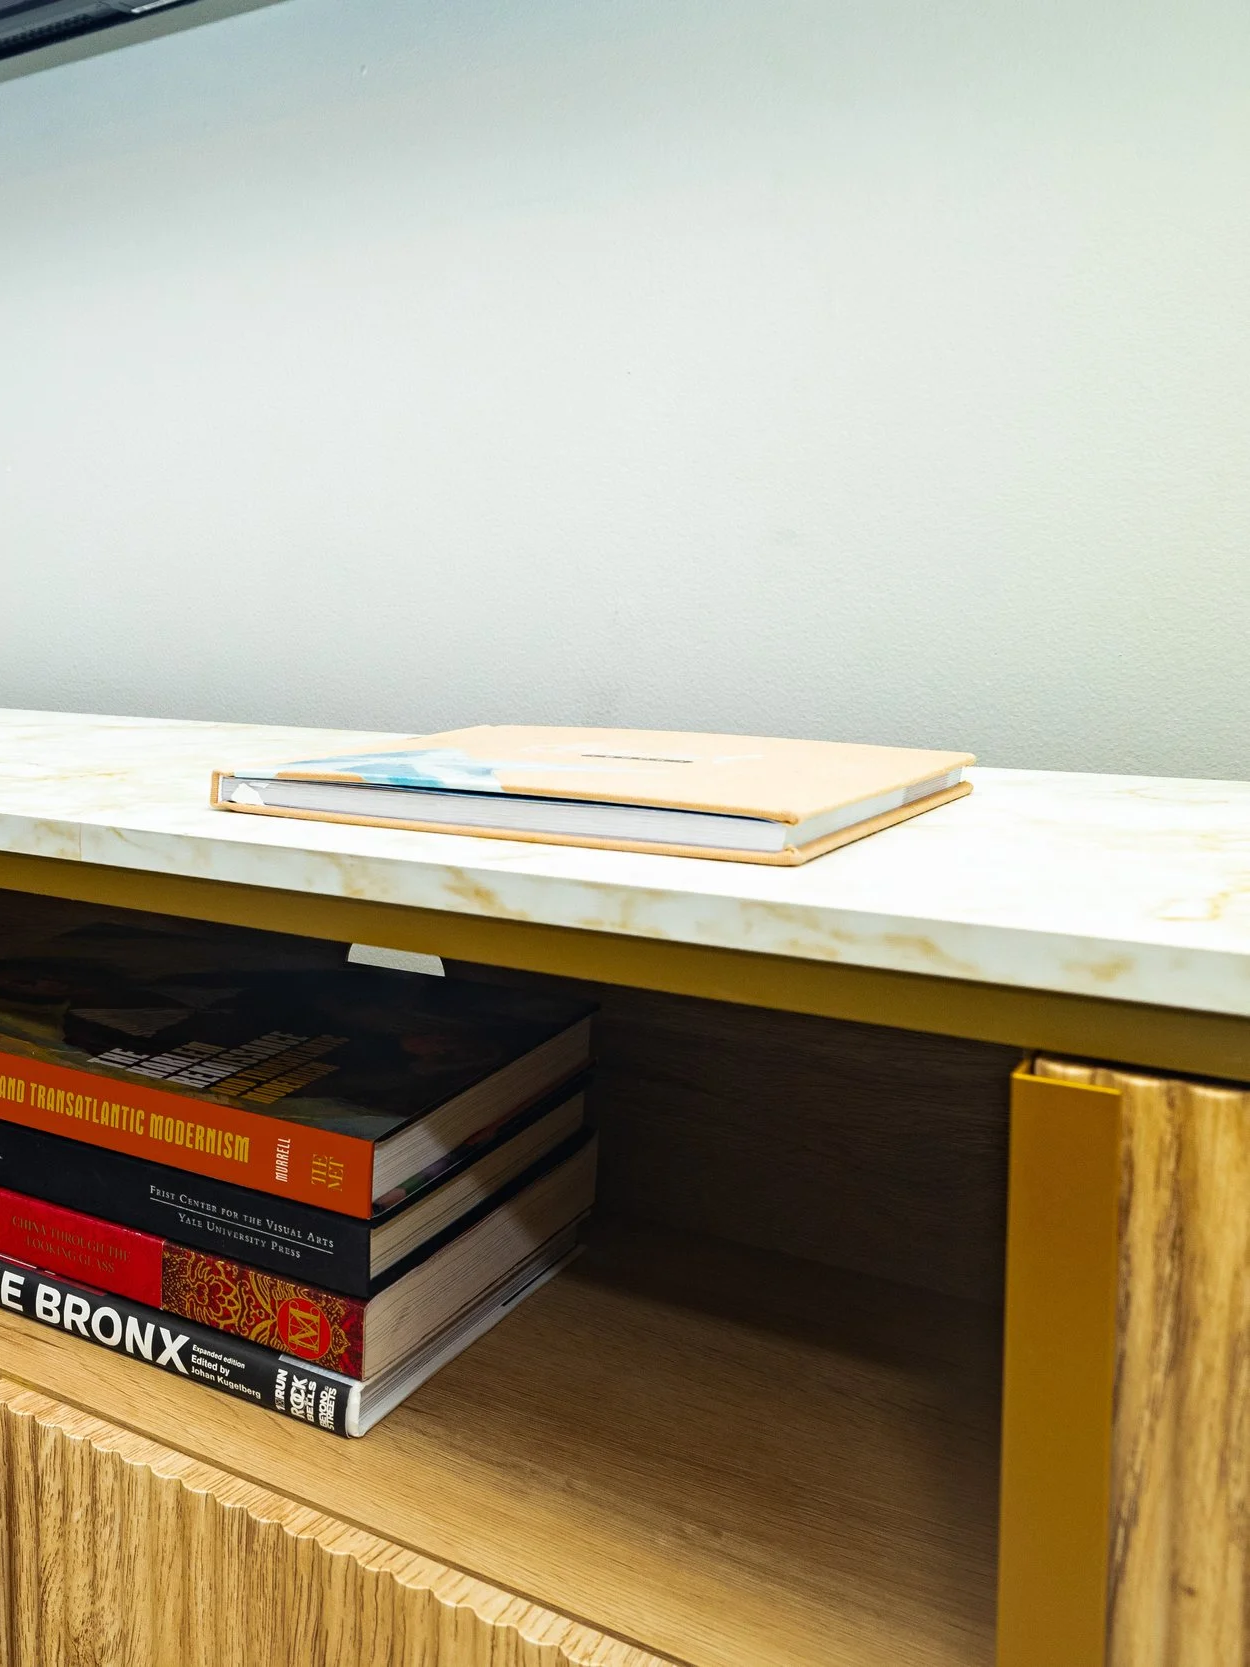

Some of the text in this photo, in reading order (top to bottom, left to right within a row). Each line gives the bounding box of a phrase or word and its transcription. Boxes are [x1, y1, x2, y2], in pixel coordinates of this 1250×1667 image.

[30, 1082, 145, 1136] TRANSATLANTIC
[150, 1113, 250, 1163] MODERNISM
[275, 1138, 291, 1183] MURRELL
[327, 1156, 344, 1192] MET
[12, 1215, 130, 1262] CHINA THROUGH THE
[150, 1185, 176, 1201] FRIST
[179, 1193, 217, 1213] CENTER
[265, 1219, 302, 1239] VISUAL
[307, 1232, 334, 1249] ARTS
[178, 1213, 301, 1259] YALE UNIVERSITY PRESS
[26, 1236, 116, 1274] LOOKING GLASS
[35, 1283, 191, 1375] BRONX
[191, 1354, 230, 1377] Edited by
[192, 1344, 246, 1369] Expanded edition
[191, 1365, 261, 1400] Johan Kugelberg
[290, 1374, 308, 1419] ROCK
[306, 1380, 317, 1422] BELLS
[318, 1390, 328, 1427] BEYOND
[327, 1387, 337, 1431] STREETS
